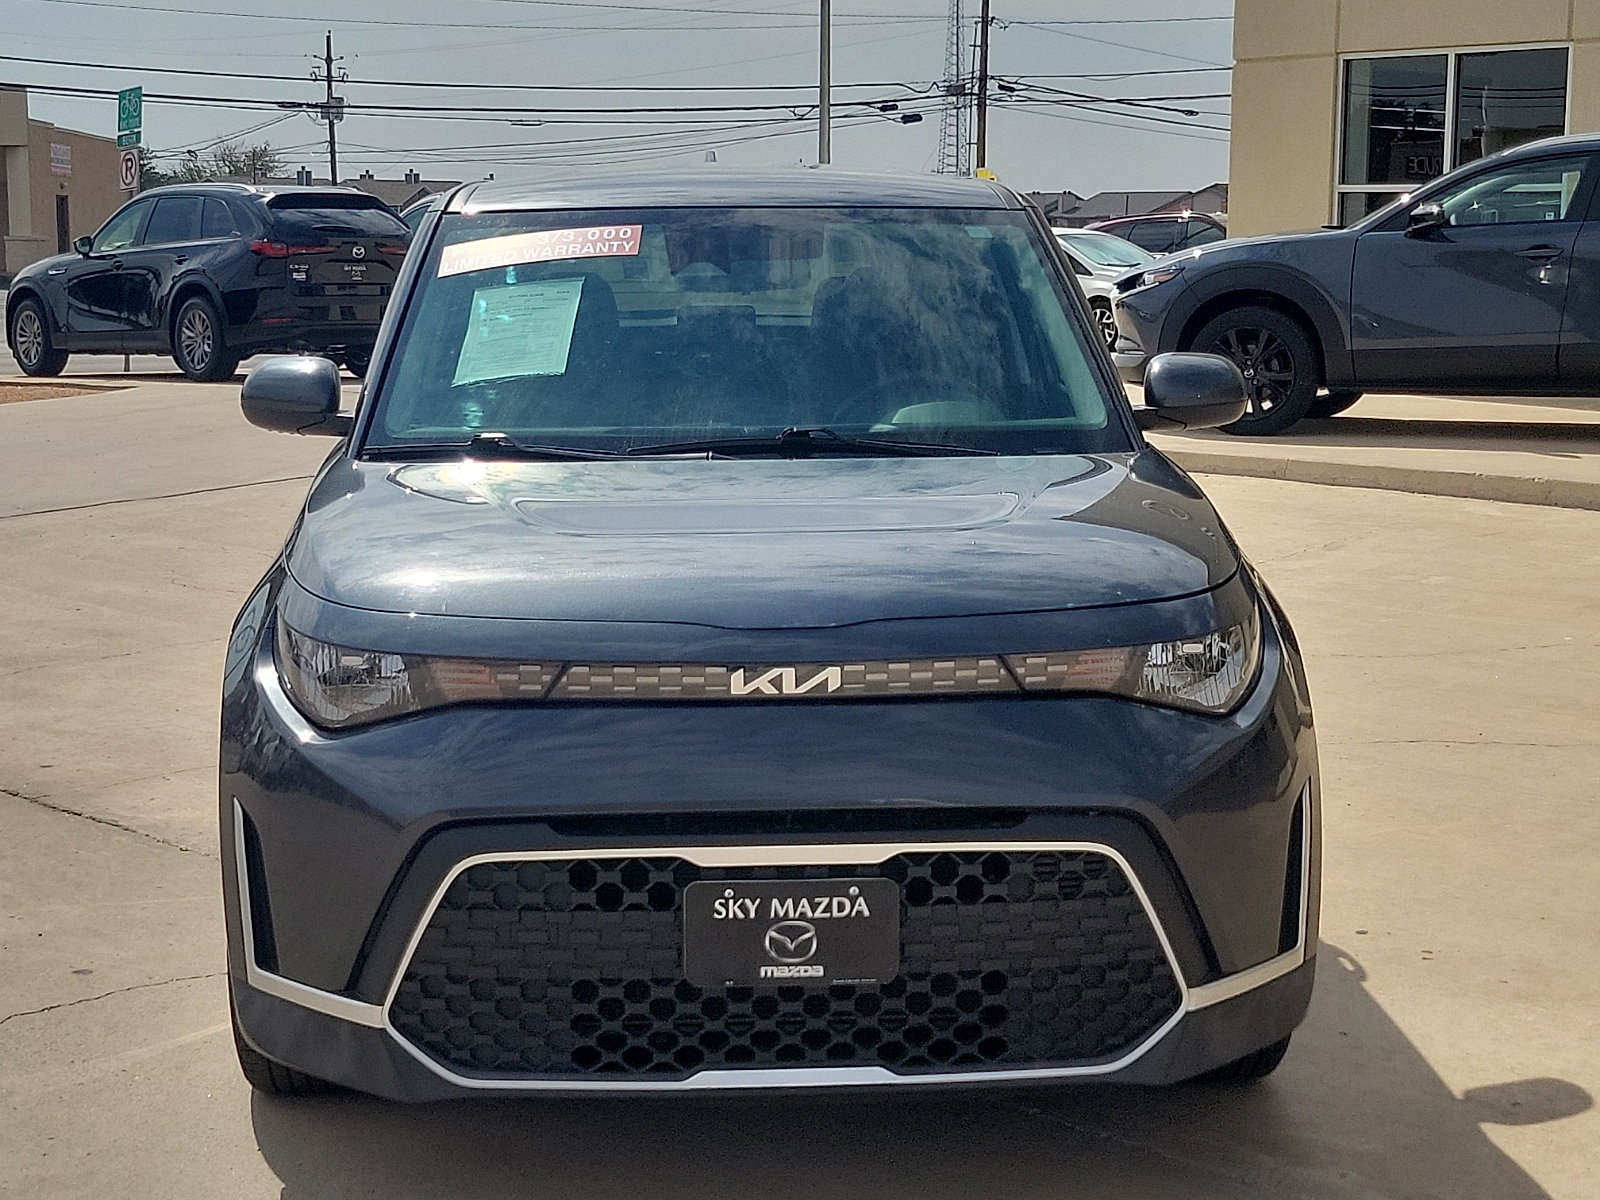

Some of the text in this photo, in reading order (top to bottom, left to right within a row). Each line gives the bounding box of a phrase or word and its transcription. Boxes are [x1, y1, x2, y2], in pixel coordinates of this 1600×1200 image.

[442, 240, 635, 273] LIMITED WARRANTY
[730, 666, 842, 695] KIA
[713, 896, 871, 920] SKY MAZDA
[759, 964, 825, 979] mazda
